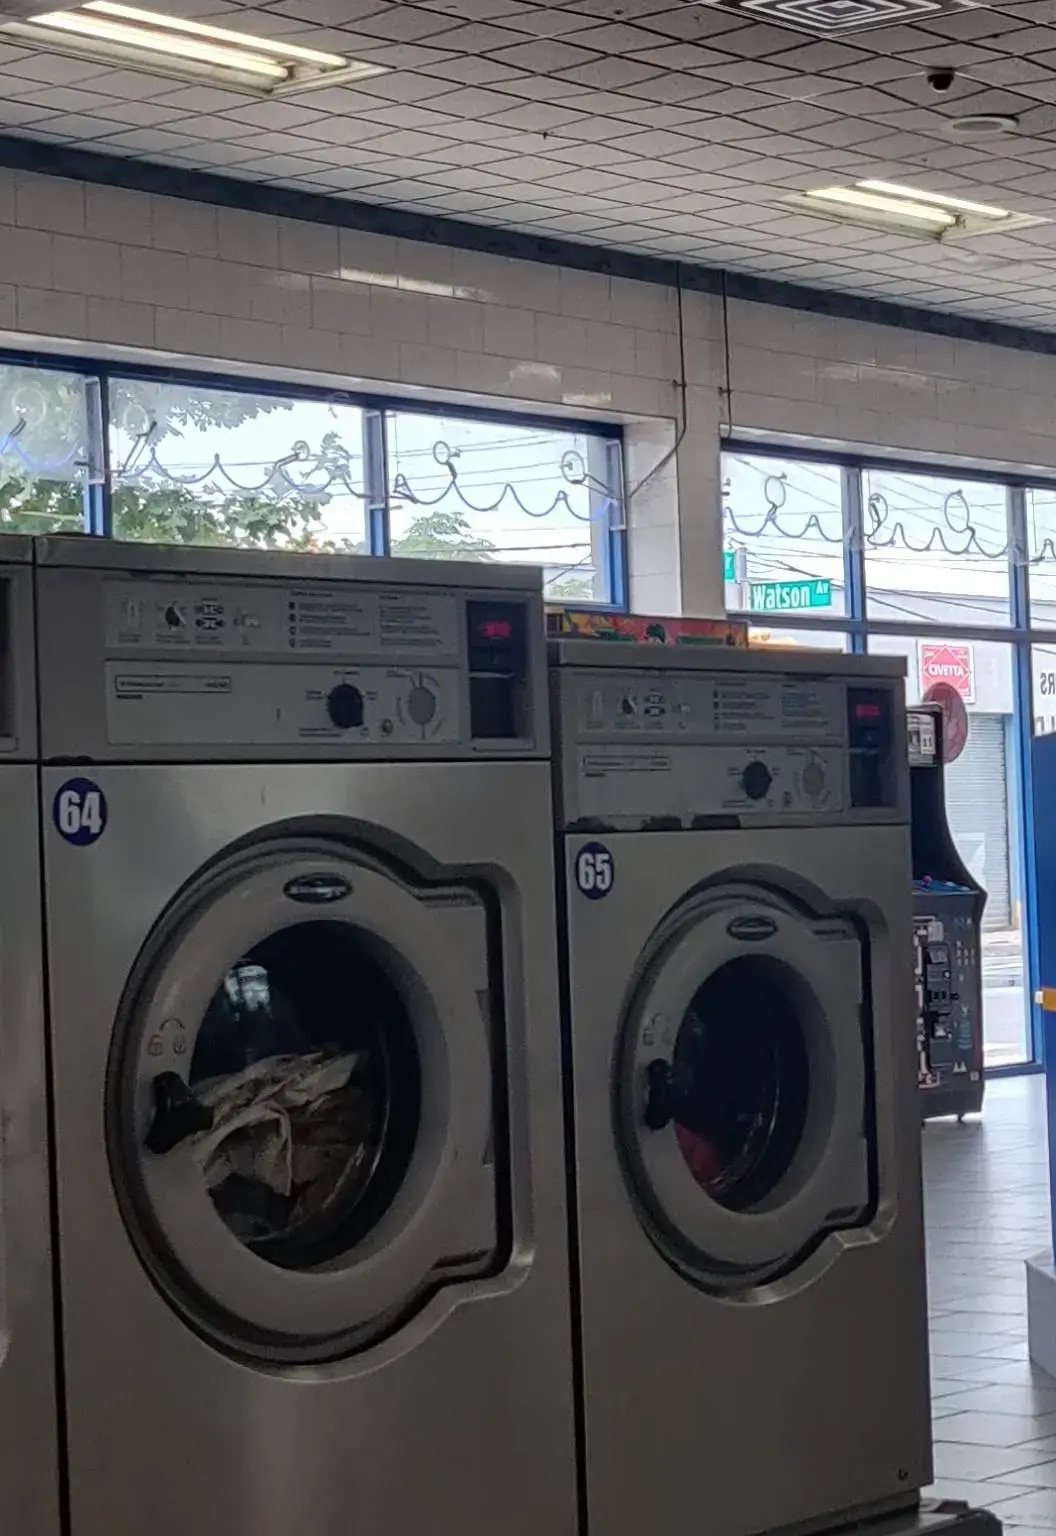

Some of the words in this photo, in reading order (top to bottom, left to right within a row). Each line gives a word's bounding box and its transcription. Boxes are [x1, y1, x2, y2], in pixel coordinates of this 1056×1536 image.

[752, 583, 811, 611] Watson
[928, 664, 965, 677] CIVETTA
[59, 790, 102, 834] 64
[578, 852, 611, 891] 65
